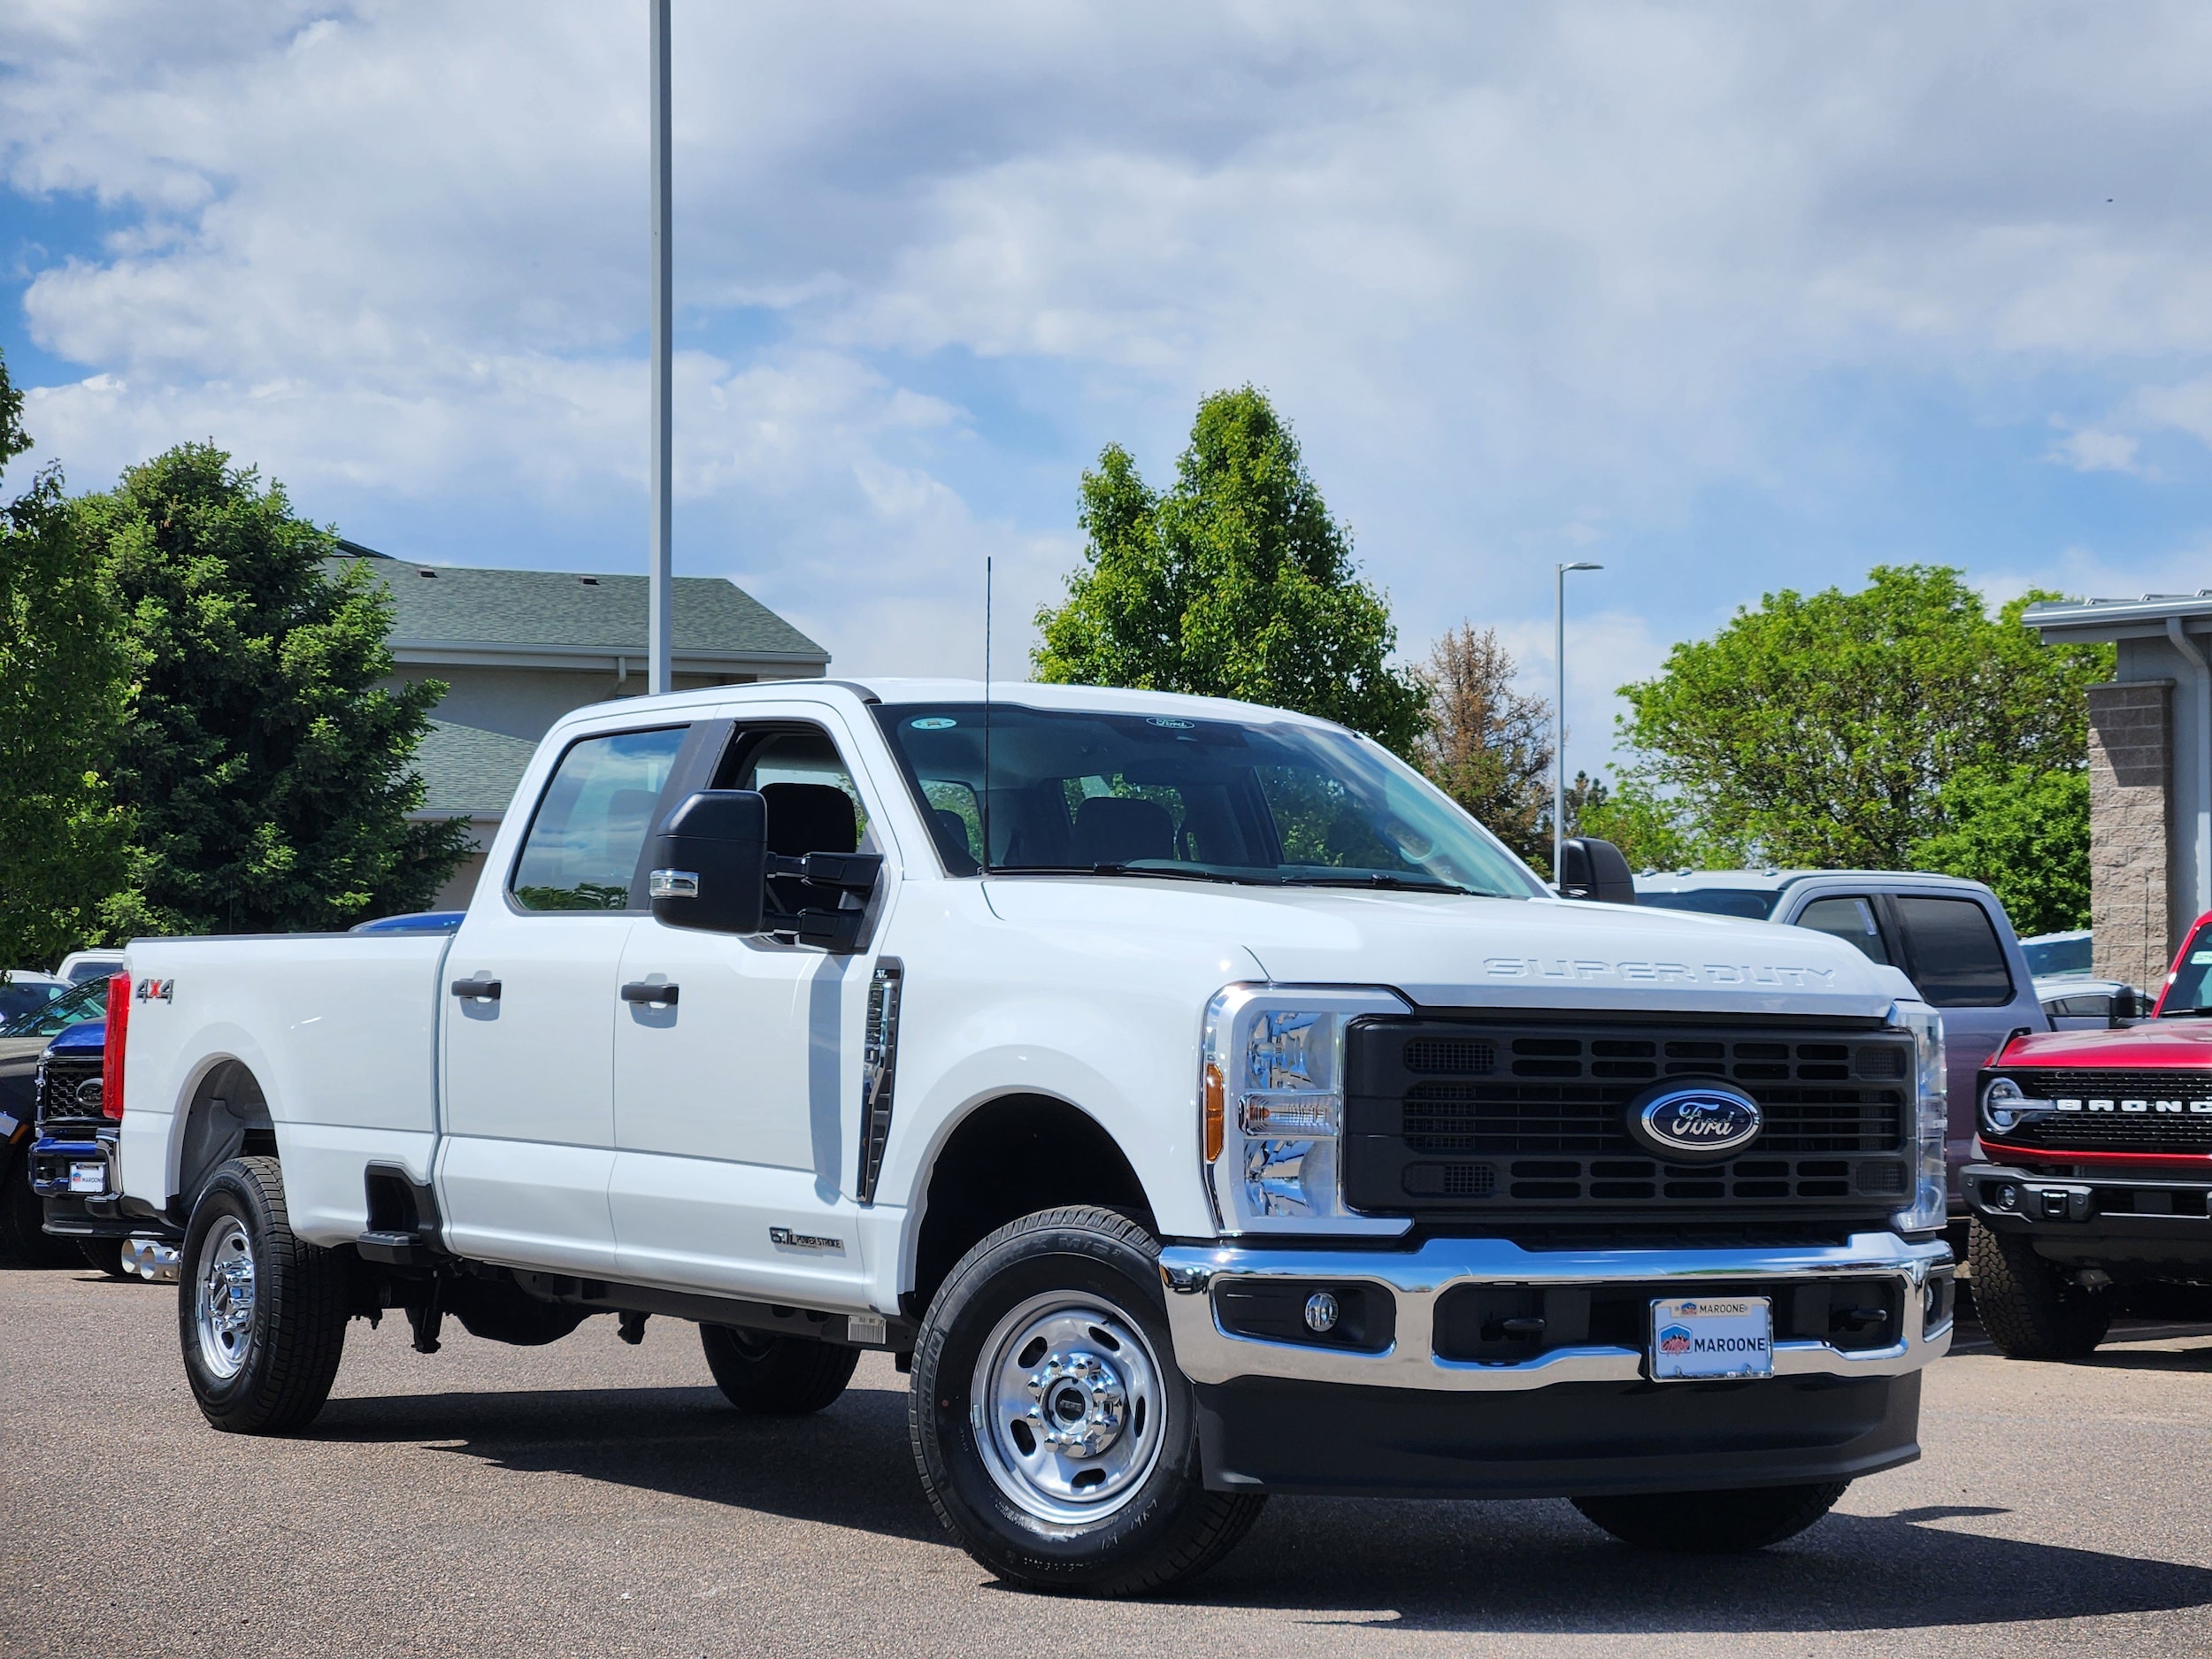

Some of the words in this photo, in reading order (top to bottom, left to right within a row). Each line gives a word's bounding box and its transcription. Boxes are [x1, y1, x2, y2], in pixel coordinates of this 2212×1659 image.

[1483, 957, 1698, 983] SUPER
[1703, 964, 1835, 987] DUTY
[1671, 1102, 1735, 1135] Ford
[1699, 1303, 1746, 1314] MAROONE
[1694, 1337, 1766, 1353] MAROONE
